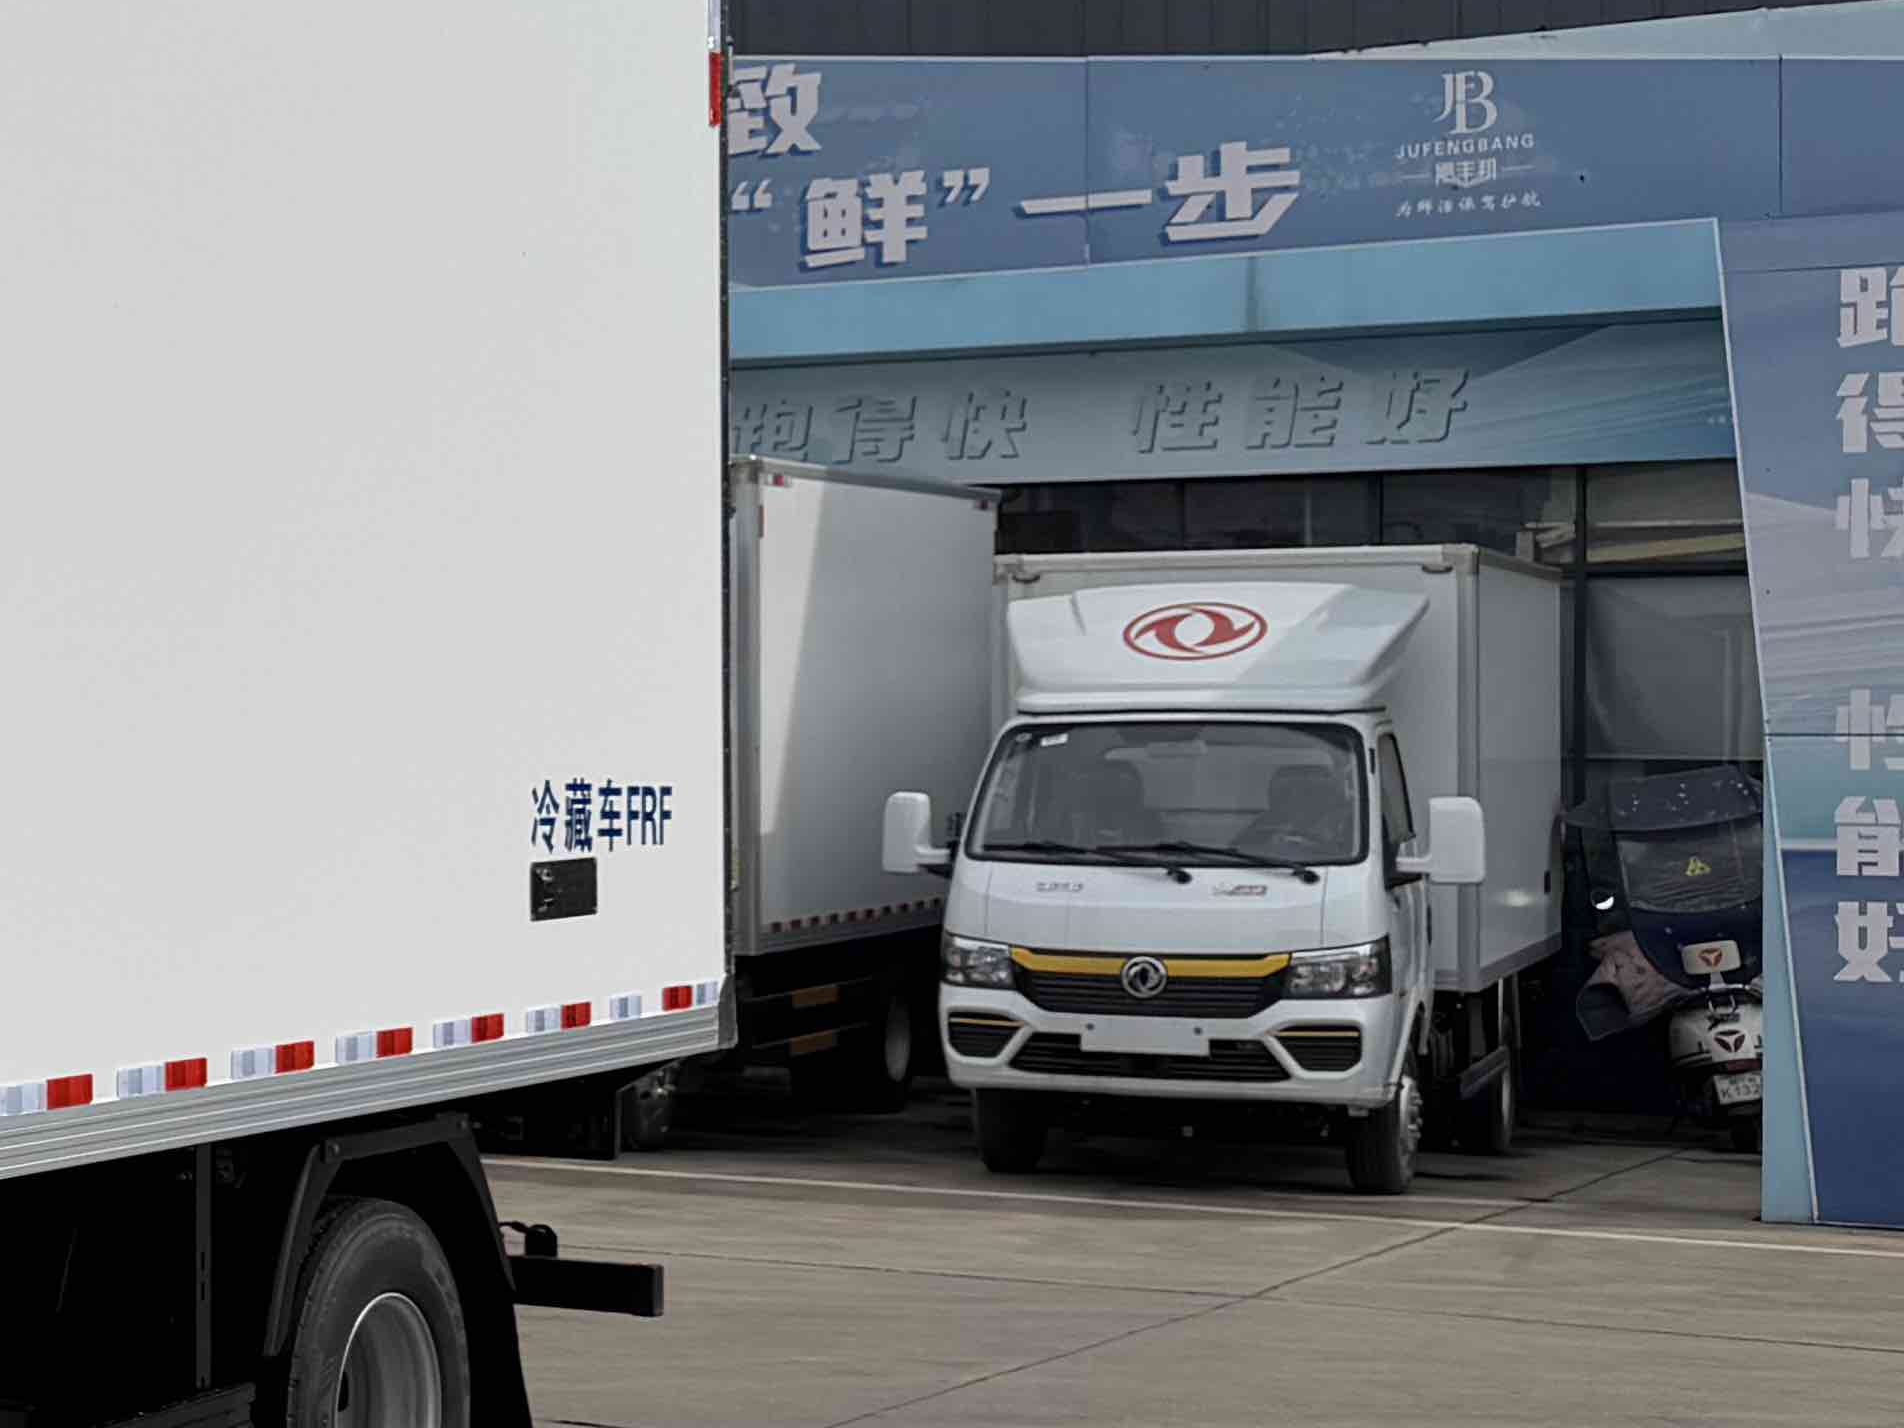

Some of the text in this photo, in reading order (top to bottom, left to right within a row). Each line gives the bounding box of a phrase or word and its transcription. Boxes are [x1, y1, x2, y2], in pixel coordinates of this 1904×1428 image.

[1396, 133, 1535, 160] JUFENGBANG
[530, 777, 673, 854] 冷藏车FRF
